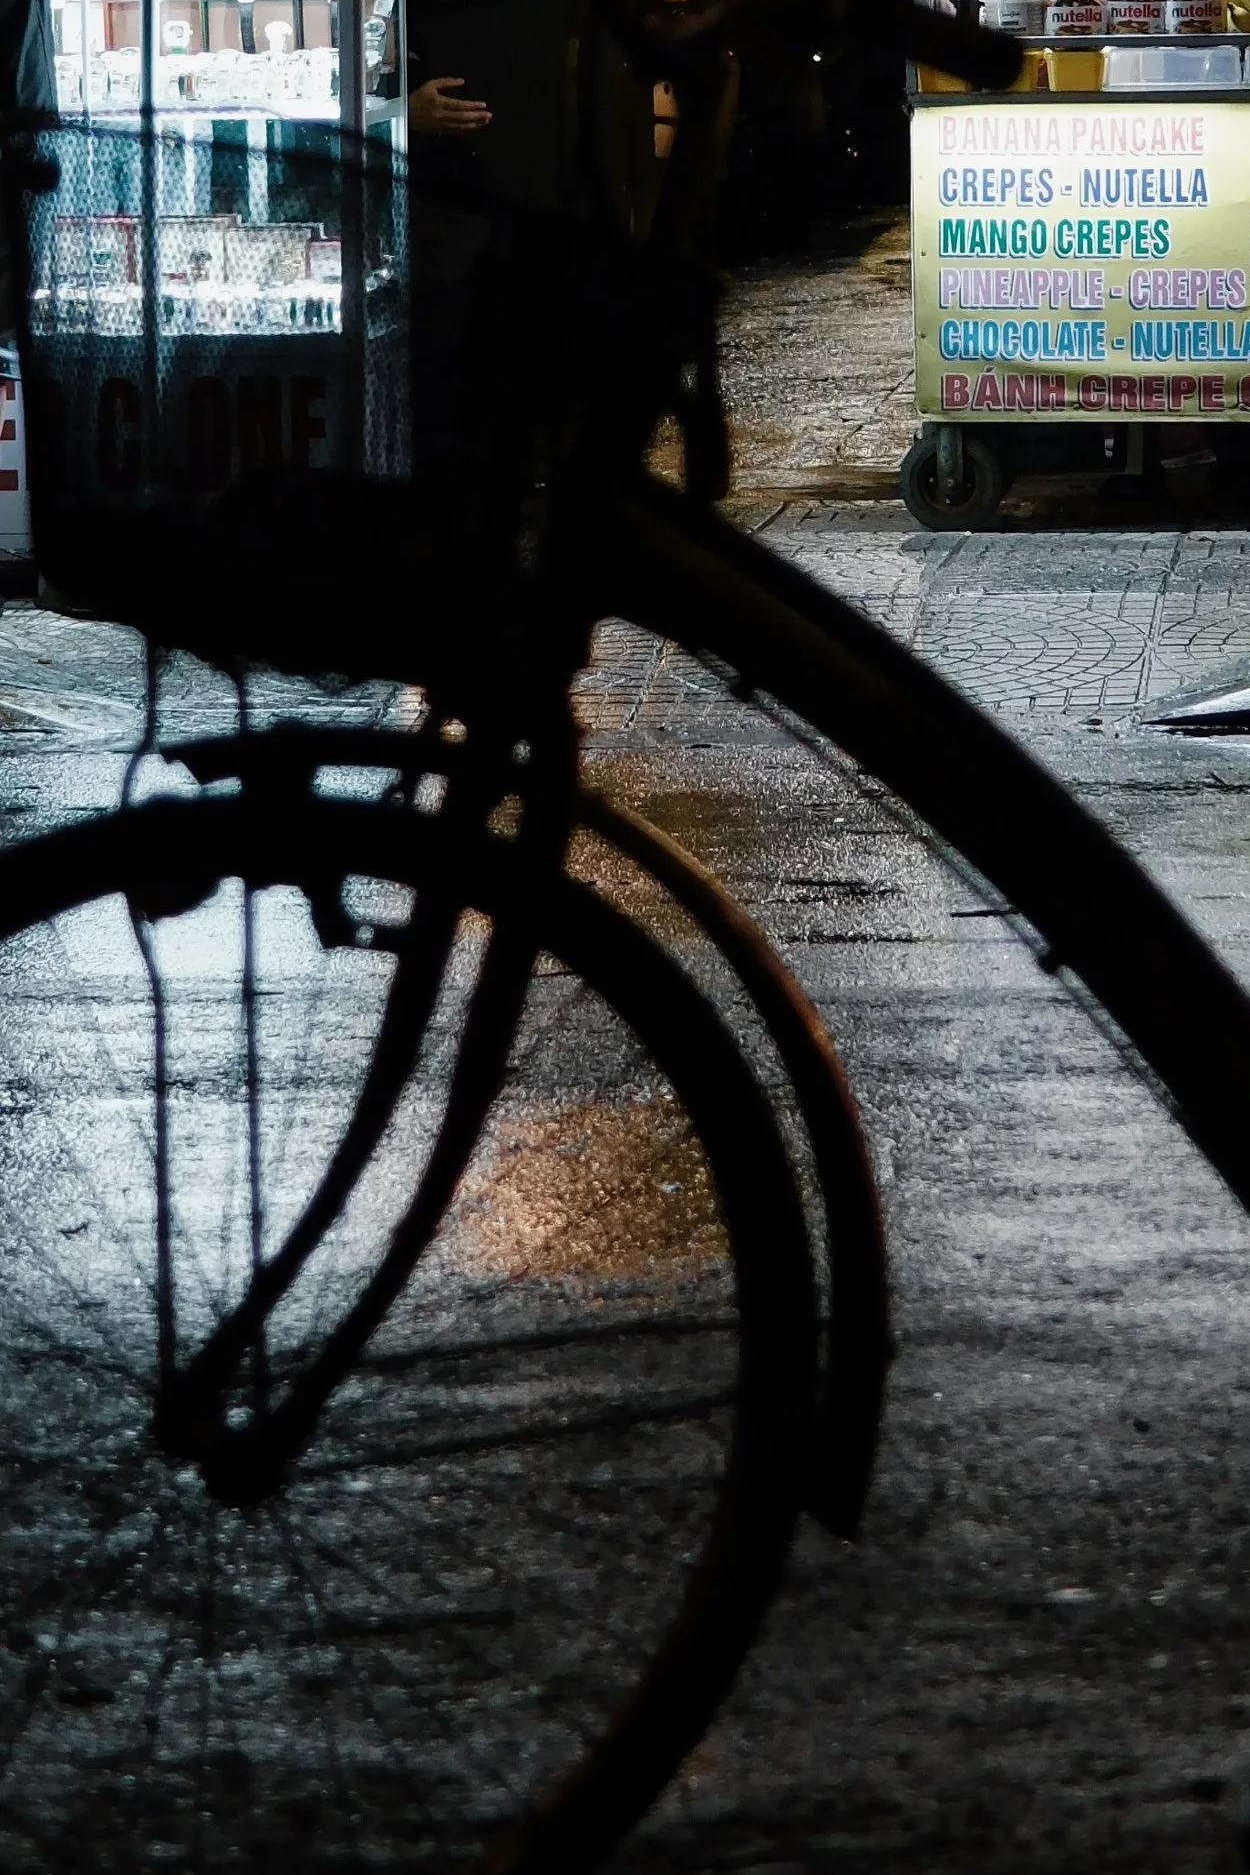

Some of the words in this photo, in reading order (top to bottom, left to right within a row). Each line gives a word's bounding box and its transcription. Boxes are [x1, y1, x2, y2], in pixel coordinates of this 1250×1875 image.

[1052, 6, 1103, 24] nutella
[1111, 1, 1161, 19] nutella
[1171, 2, 1222, 19] nutella
[941, 116, 1062, 153] BANANA
[1071, 116, 1205, 154] PANCAKE
[940, 167, 1054, 205] CREPES
[1081, 168, 1209, 205] NUTELLA
[940, 218, 1049, 256] MANGO
[1054, 218, 1171, 256] CREPES
[940, 269, 1104, 308] PINEAPPLE
[1129, 269, 1247, 309] CREPES
[940, 320, 1107, 360] CHOCOLATE
[941, 364, 1067, 410] BÁNH
[1078, 374, 1227, 411] CREPE
